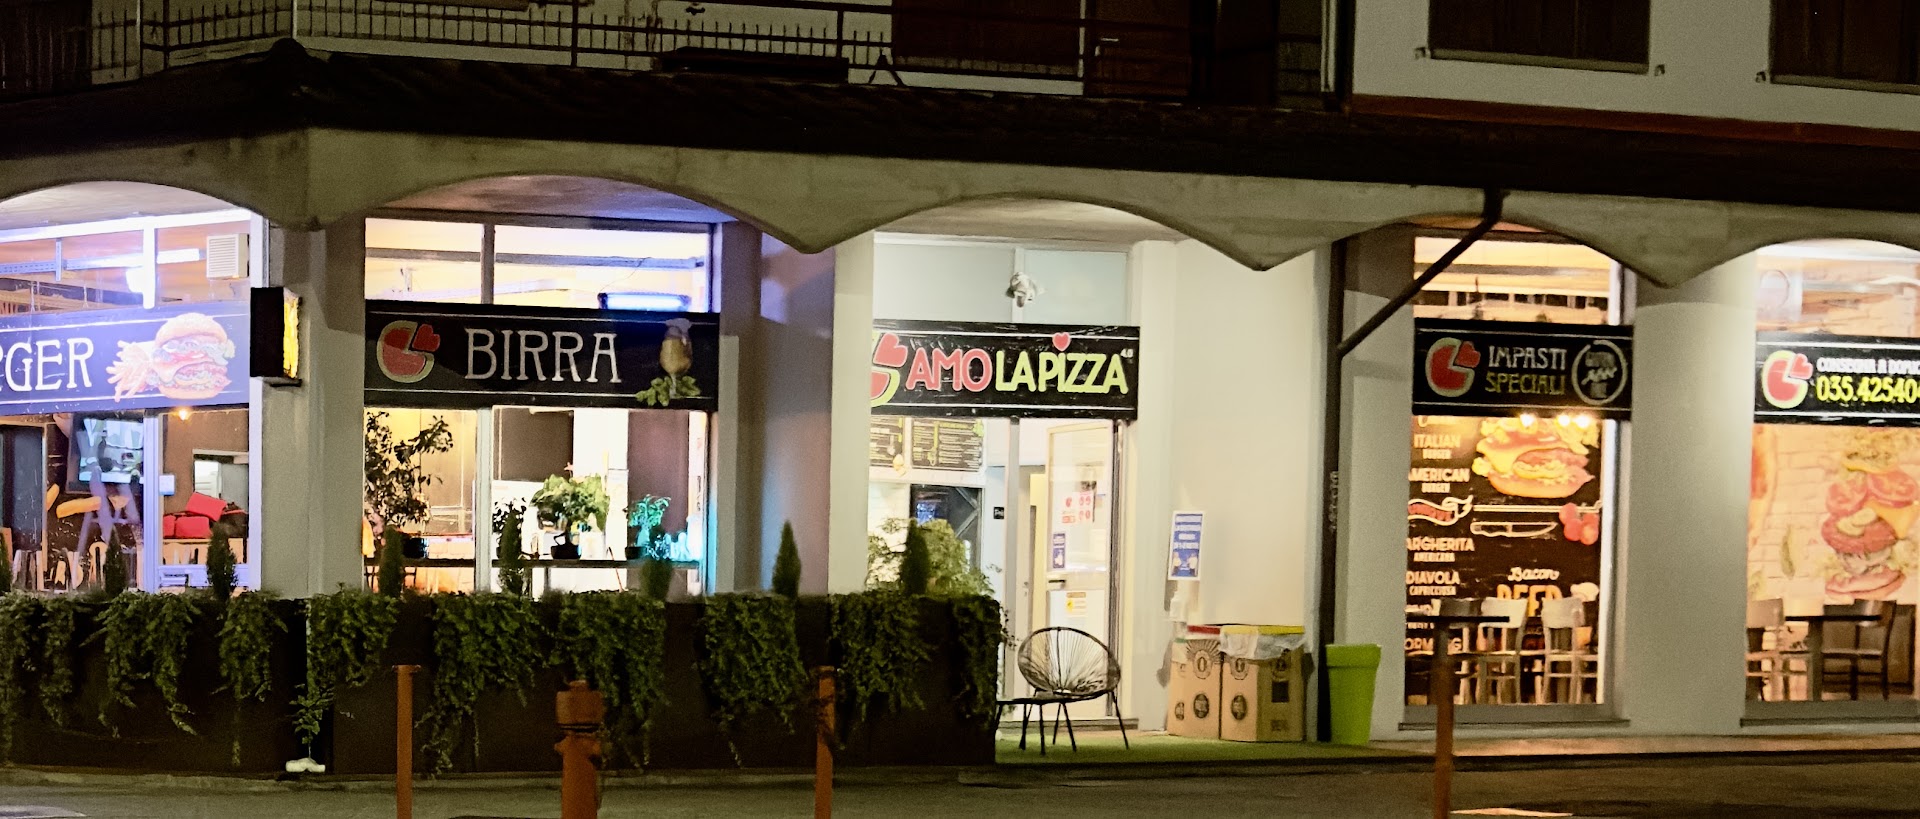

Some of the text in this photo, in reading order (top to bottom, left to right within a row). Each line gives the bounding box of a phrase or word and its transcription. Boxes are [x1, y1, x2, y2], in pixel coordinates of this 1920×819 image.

[0, 337, 94, 392] GER
[464, 328, 622, 383] BIRRA
[1488, 345, 1567, 370] IMPASTI
[905, 347, 993, 392] AMO
[1484, 372, 1566, 395] SPECIALI
[1816, 375, 1920, 404] 035.42540
[1413, 433, 1461, 448] ITALIAN
[1405, 571, 1461, 585] DIAVOLA
